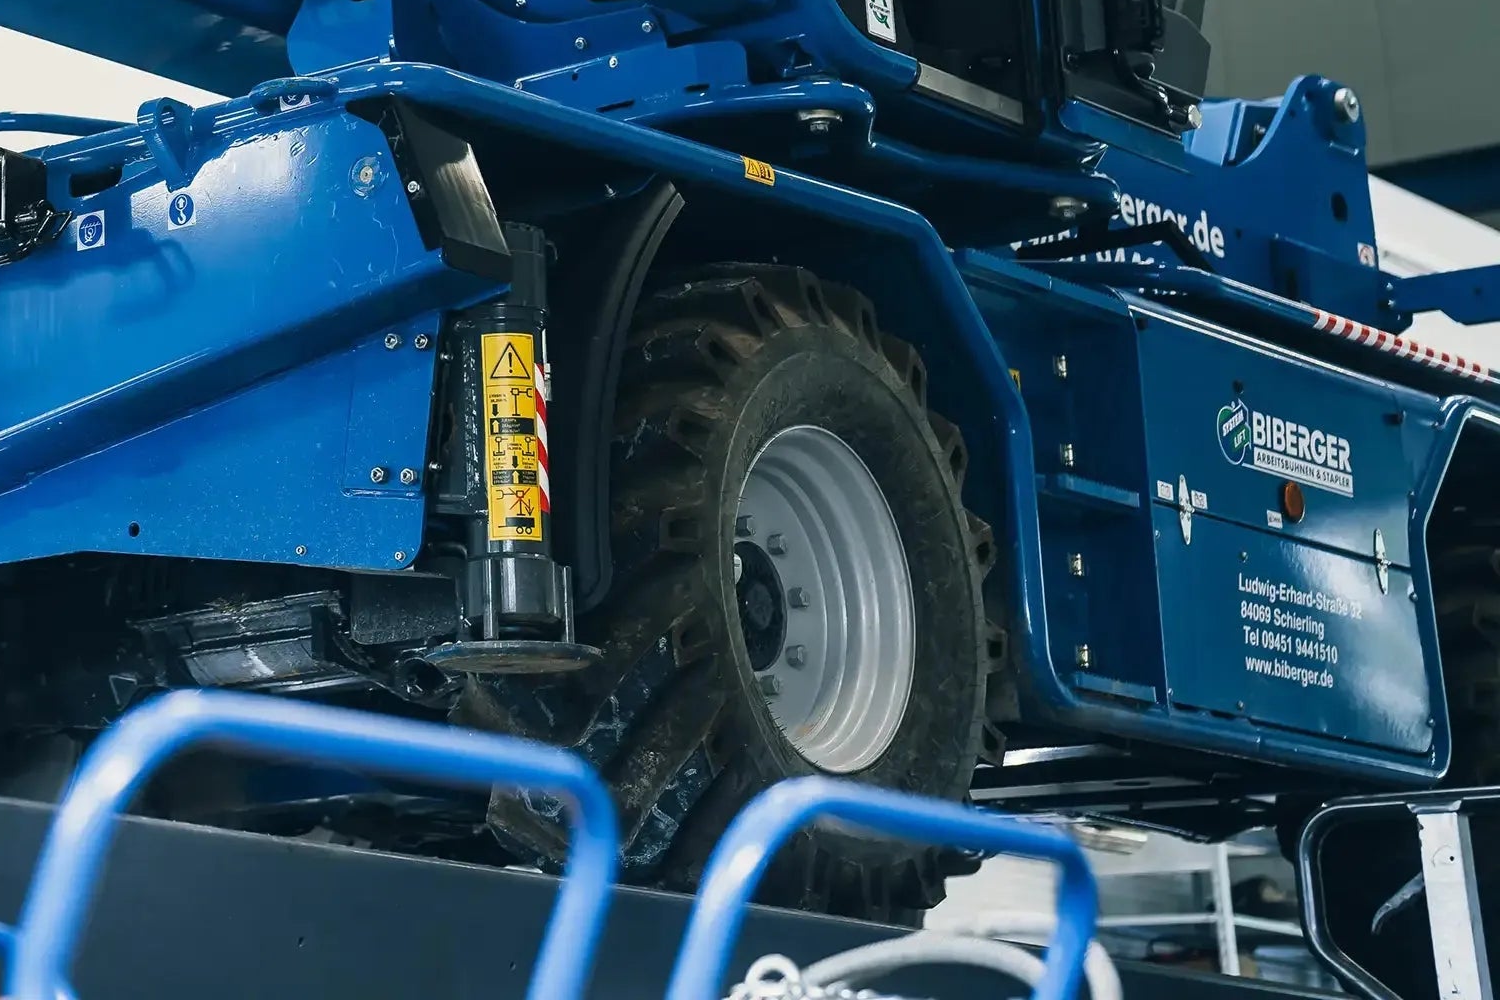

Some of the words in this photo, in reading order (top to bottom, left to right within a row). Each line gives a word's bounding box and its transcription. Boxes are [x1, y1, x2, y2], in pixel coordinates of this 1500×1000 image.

[1222, 409, 1244, 437] SYSTEM
[1233, 429, 1246, 448] LIFT
[1252, 410, 1352, 473] BIBERGER
[1322, 471, 1350, 488] STAPLER
[1238, 572, 1348, 616] Ludwig-Erhard-Straße
[1240, 601, 1271, 624] 84069
[1273, 608, 1325, 641] Schierling
[1243, 625, 1259, 647] Tel
[1262, 630, 1292, 654] 09451
[1295, 638, 1338, 664] 9441510
[1245, 656, 1333, 688] www.biberger.de
